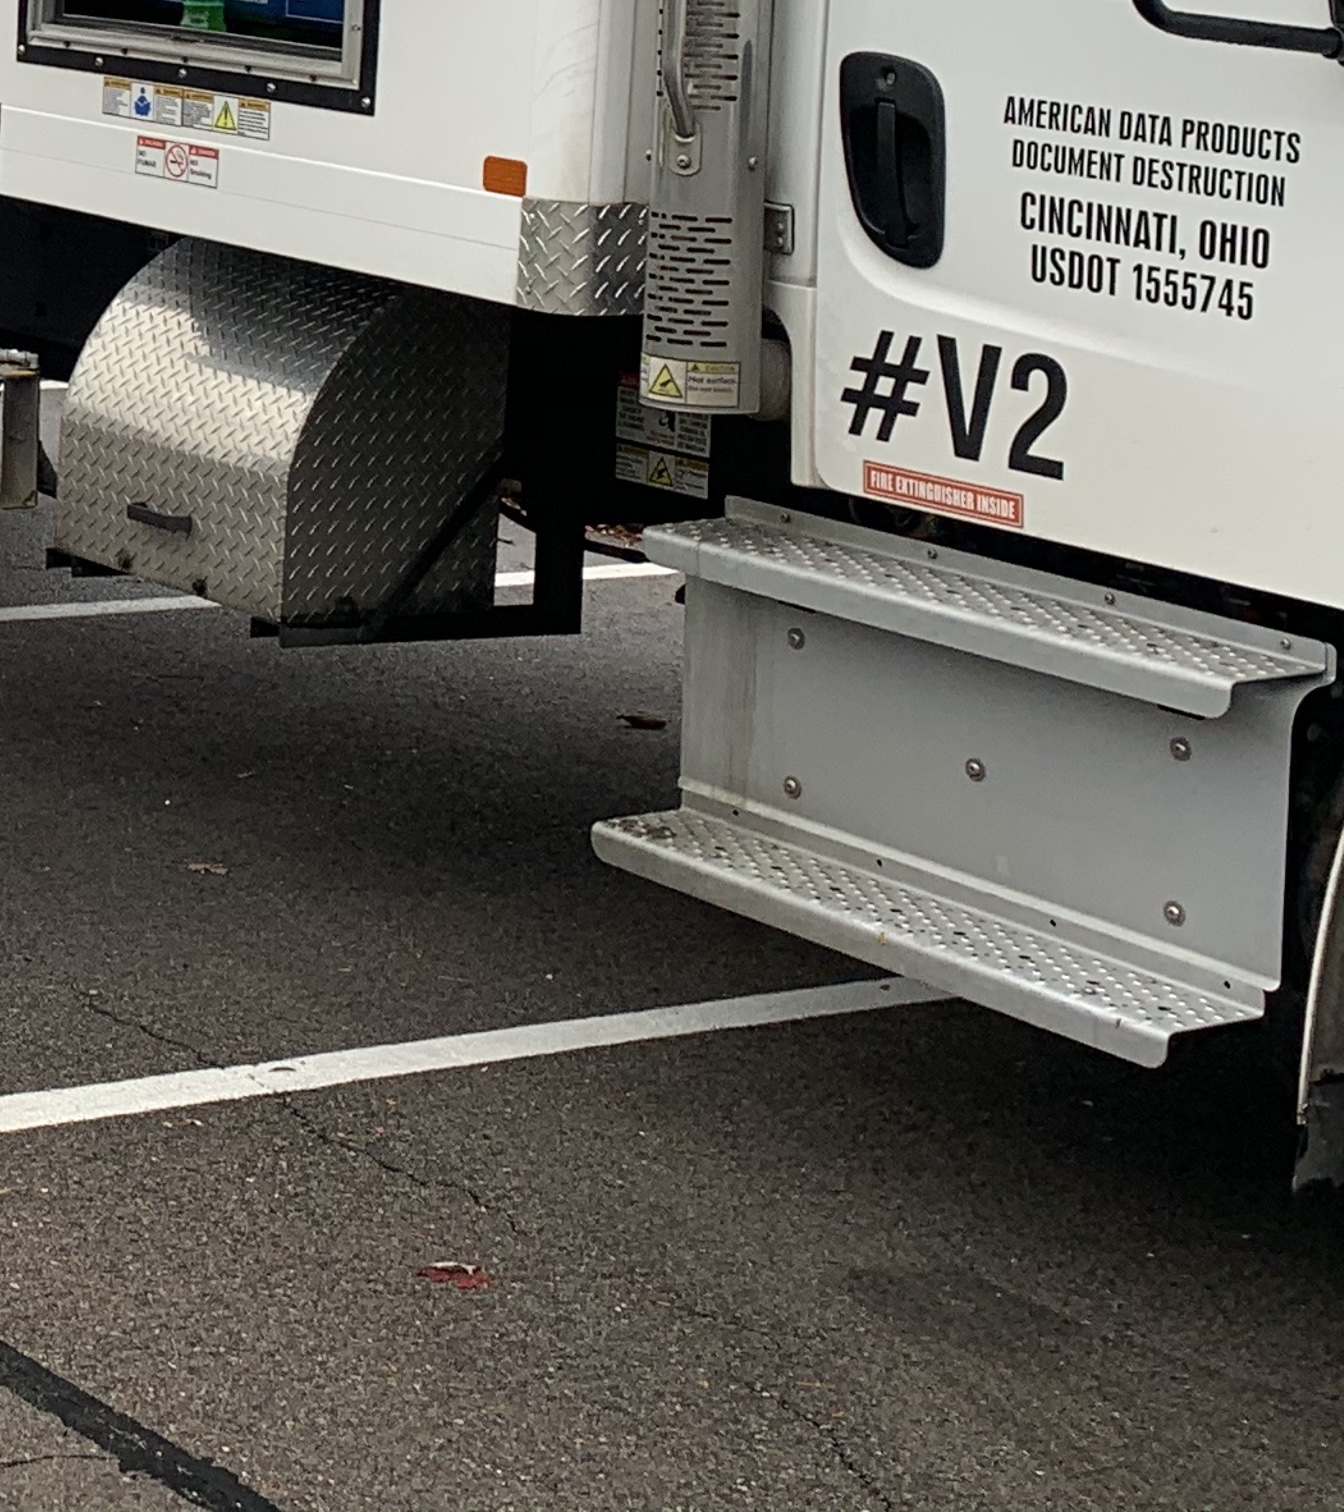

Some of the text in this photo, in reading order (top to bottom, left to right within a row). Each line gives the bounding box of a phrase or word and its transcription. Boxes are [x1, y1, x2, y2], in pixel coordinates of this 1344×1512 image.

[1003, 95, 1302, 164] AMERICAN DATA PRODUCTS
[1011, 138, 1286, 207] DOCUMENT DESTRUCTION
[1019, 191, 1271, 269] CINCINNATI, OHIO
[1030, 244, 1254, 321] USDOT 1555745
[839, 329, 1068, 481] #V2
[870, 470, 1016, 519] FIRE EXTINGUISHER INSIDE
